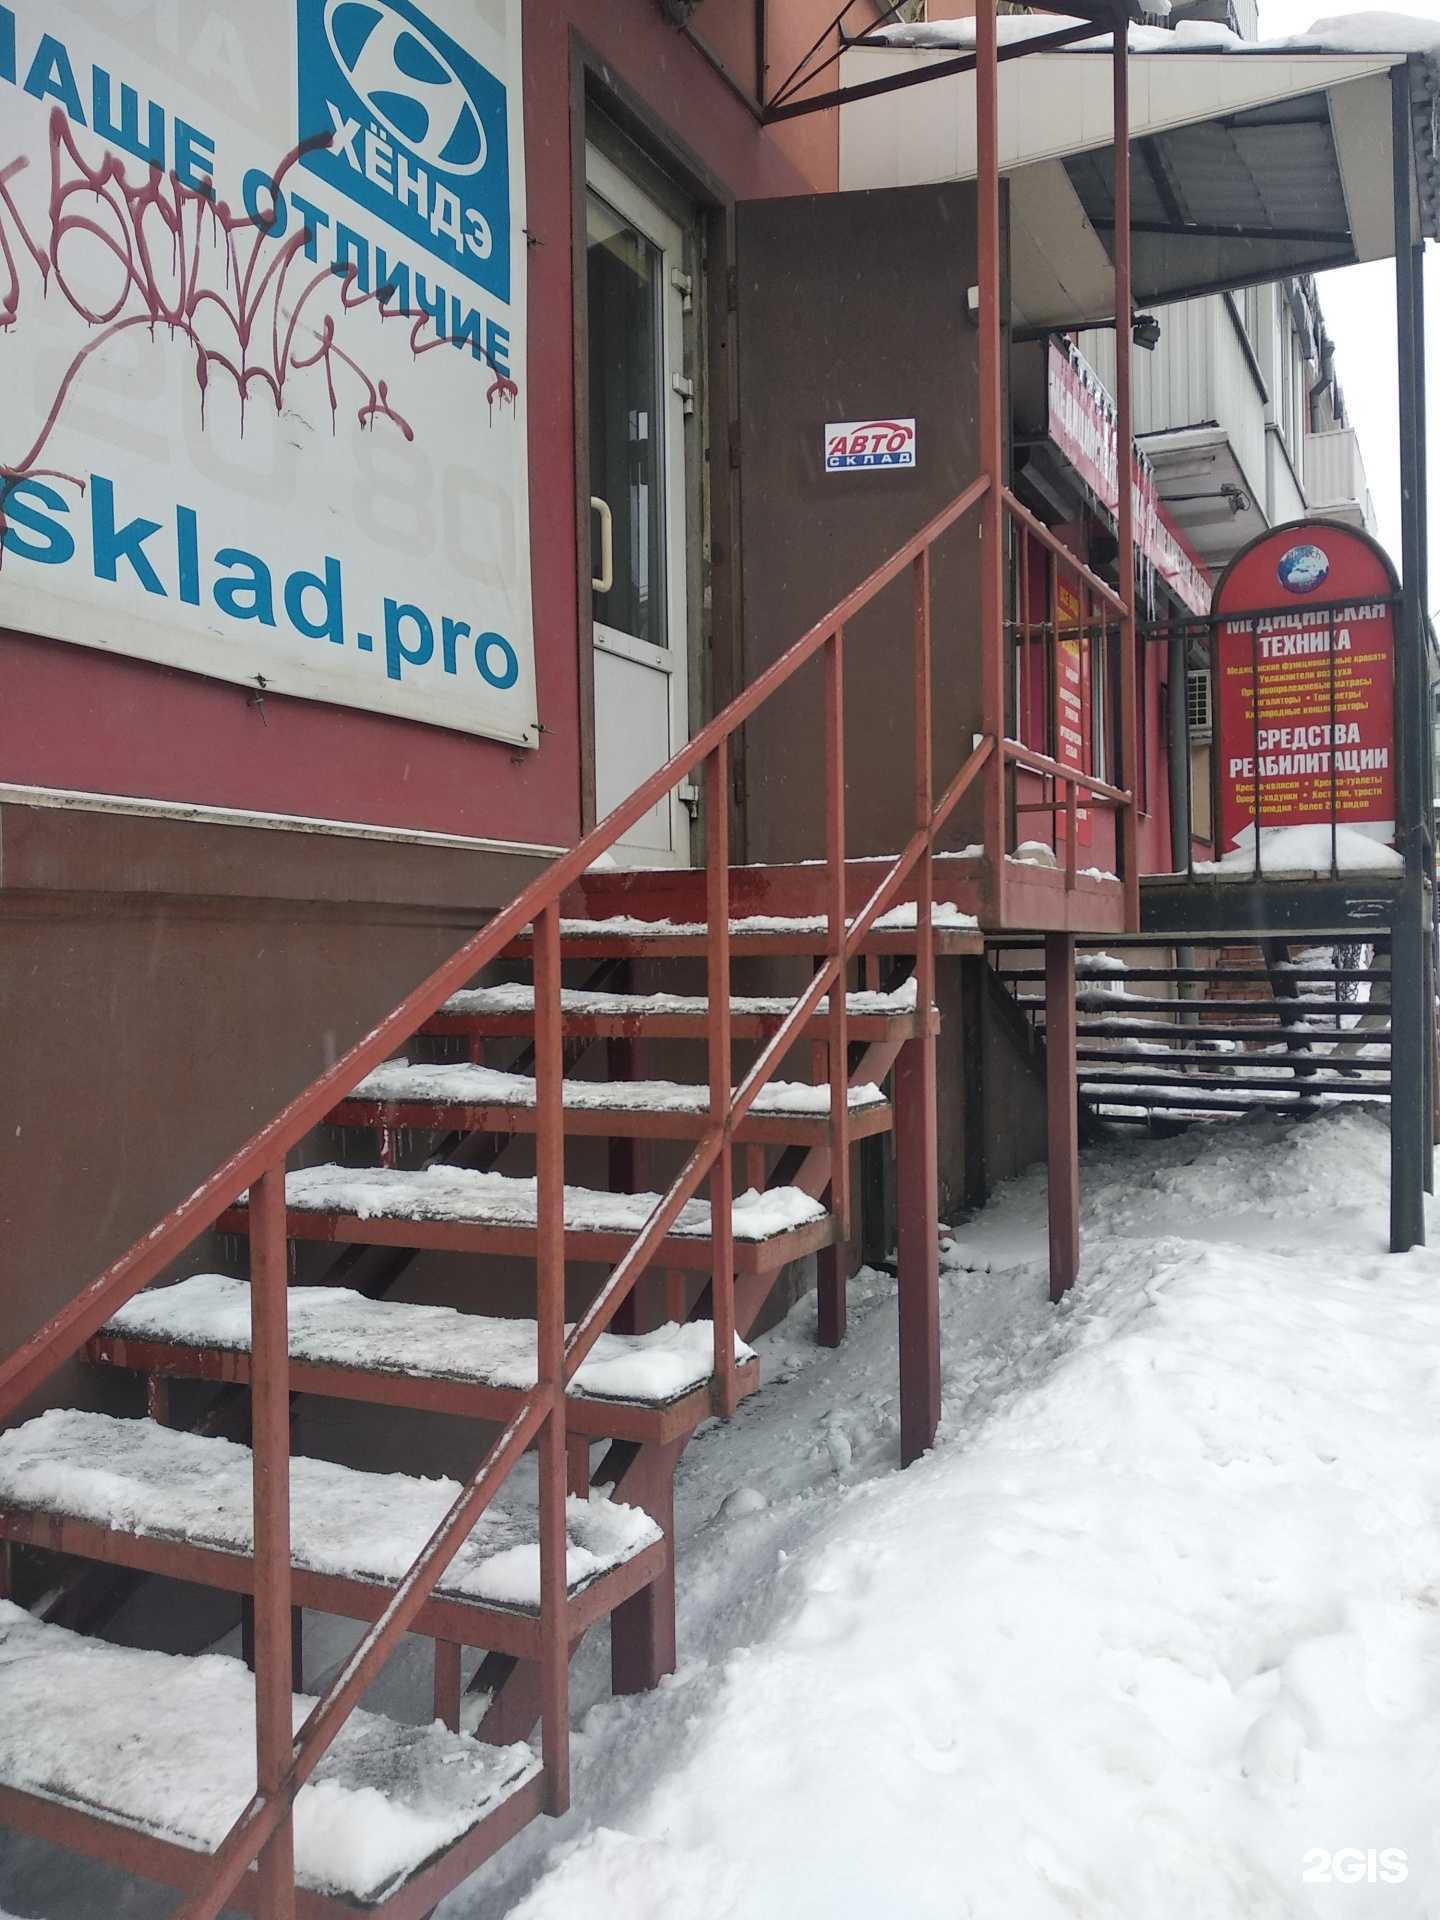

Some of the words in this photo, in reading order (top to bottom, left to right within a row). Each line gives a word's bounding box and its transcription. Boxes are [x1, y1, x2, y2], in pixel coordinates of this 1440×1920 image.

[0, 4, 216, 202] АШЕ
[243, 168, 510, 378] ОТЛИЧИЕ
[326, 99, 492, 259] ХЁНДЭ
[829, 433, 906, 455] АВТО
[829, 453, 910, 467] СКЛАД
[1257, 723, 1361, 750] СРЕДСТВА
